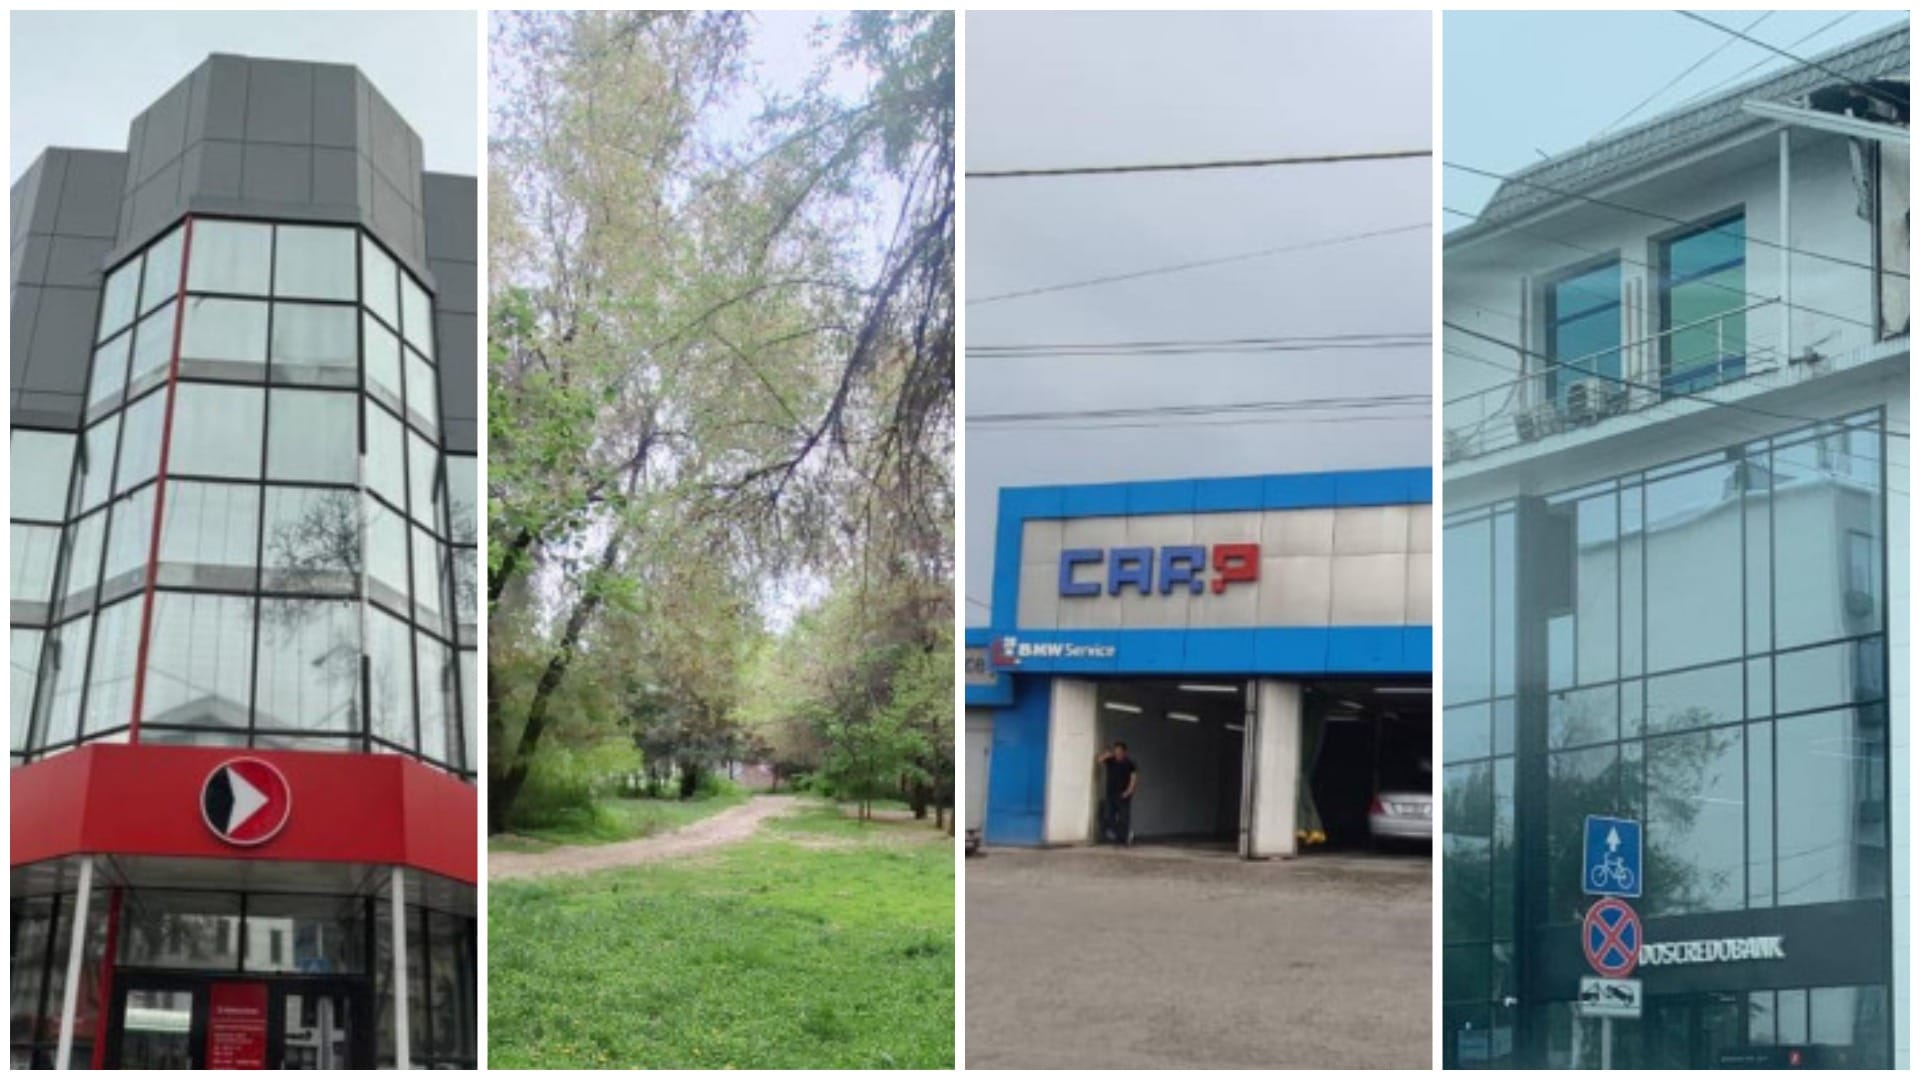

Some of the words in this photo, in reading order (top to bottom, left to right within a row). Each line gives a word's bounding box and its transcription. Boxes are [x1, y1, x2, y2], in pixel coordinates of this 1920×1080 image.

[1019, 642, 1061, 657] BMW
[1063, 642, 1116, 657] Service
[1638, 936, 1785, 966] DOSCREDOBANK
